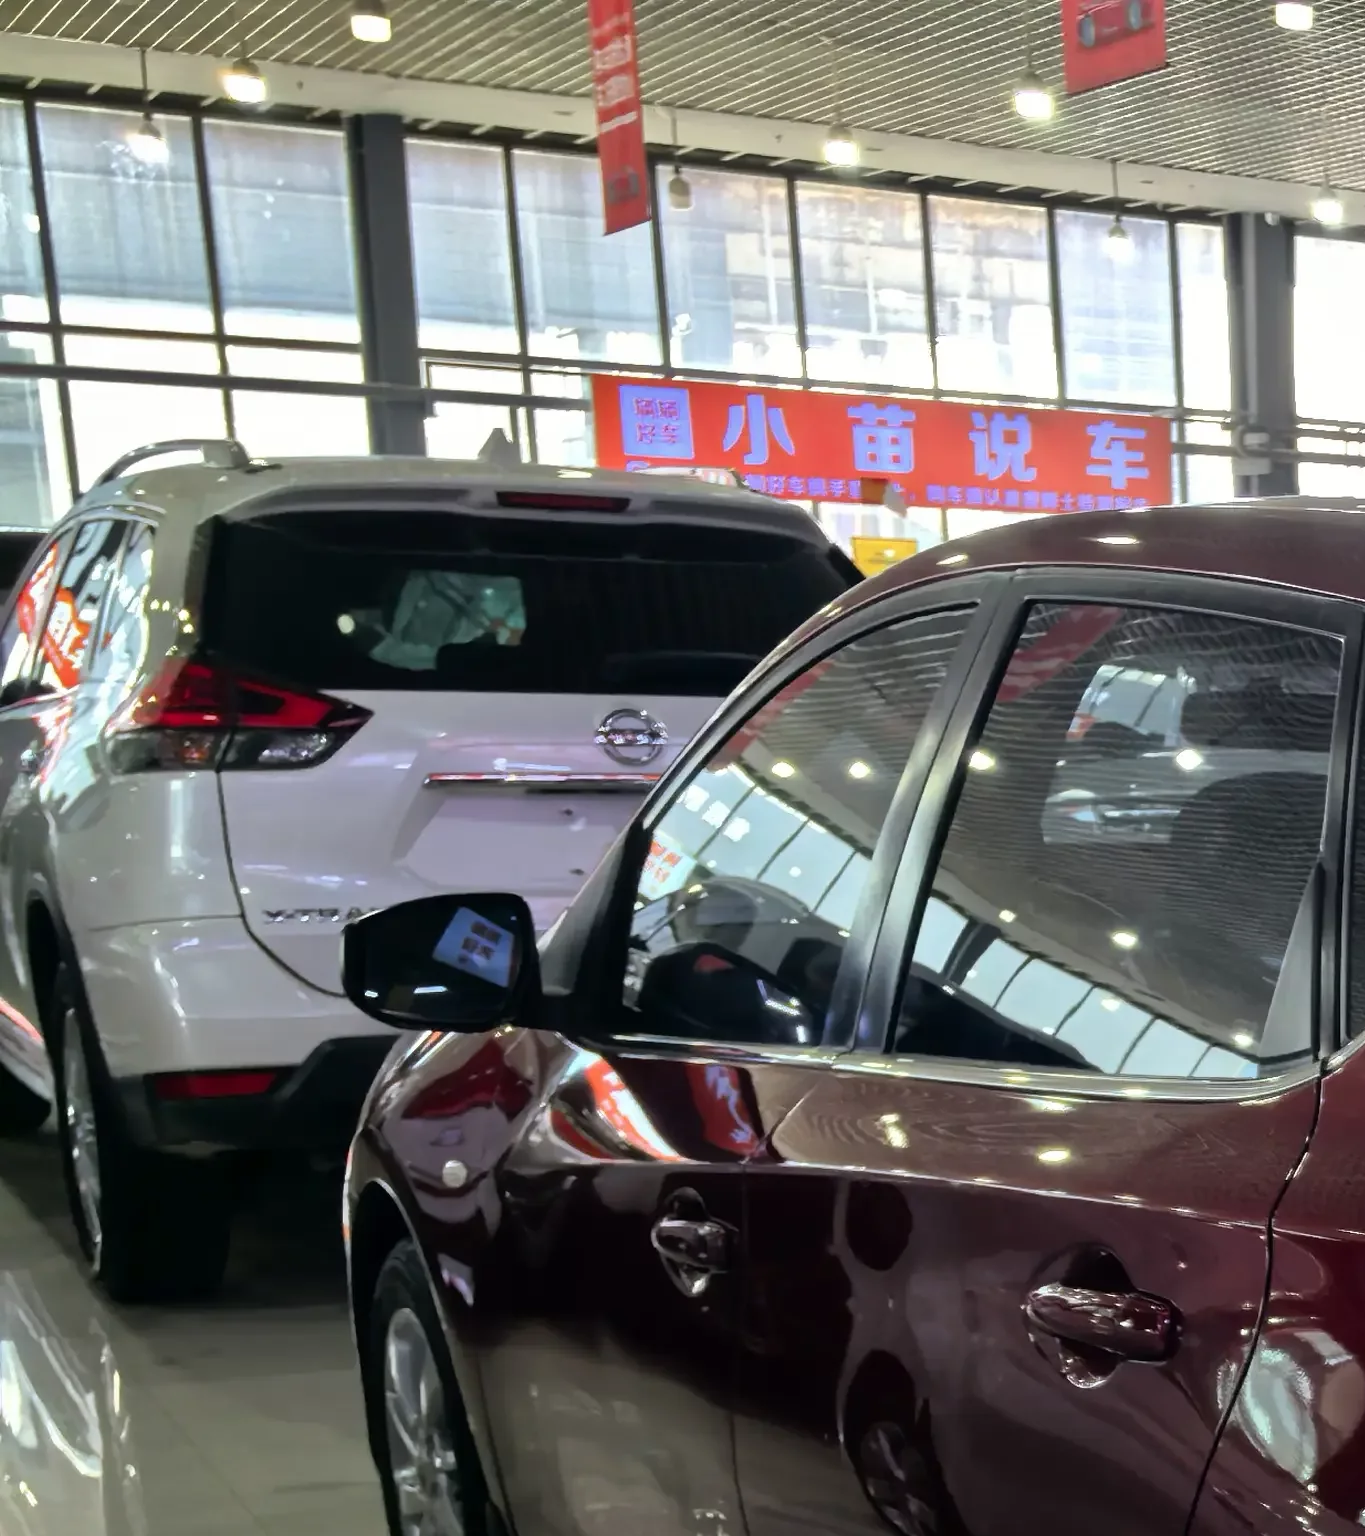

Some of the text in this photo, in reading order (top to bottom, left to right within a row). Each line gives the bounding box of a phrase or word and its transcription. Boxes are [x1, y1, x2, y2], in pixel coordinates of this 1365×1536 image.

[722, 394, 1150, 489] 小苗说车
[262, 907, 384, 924] X-TRA
